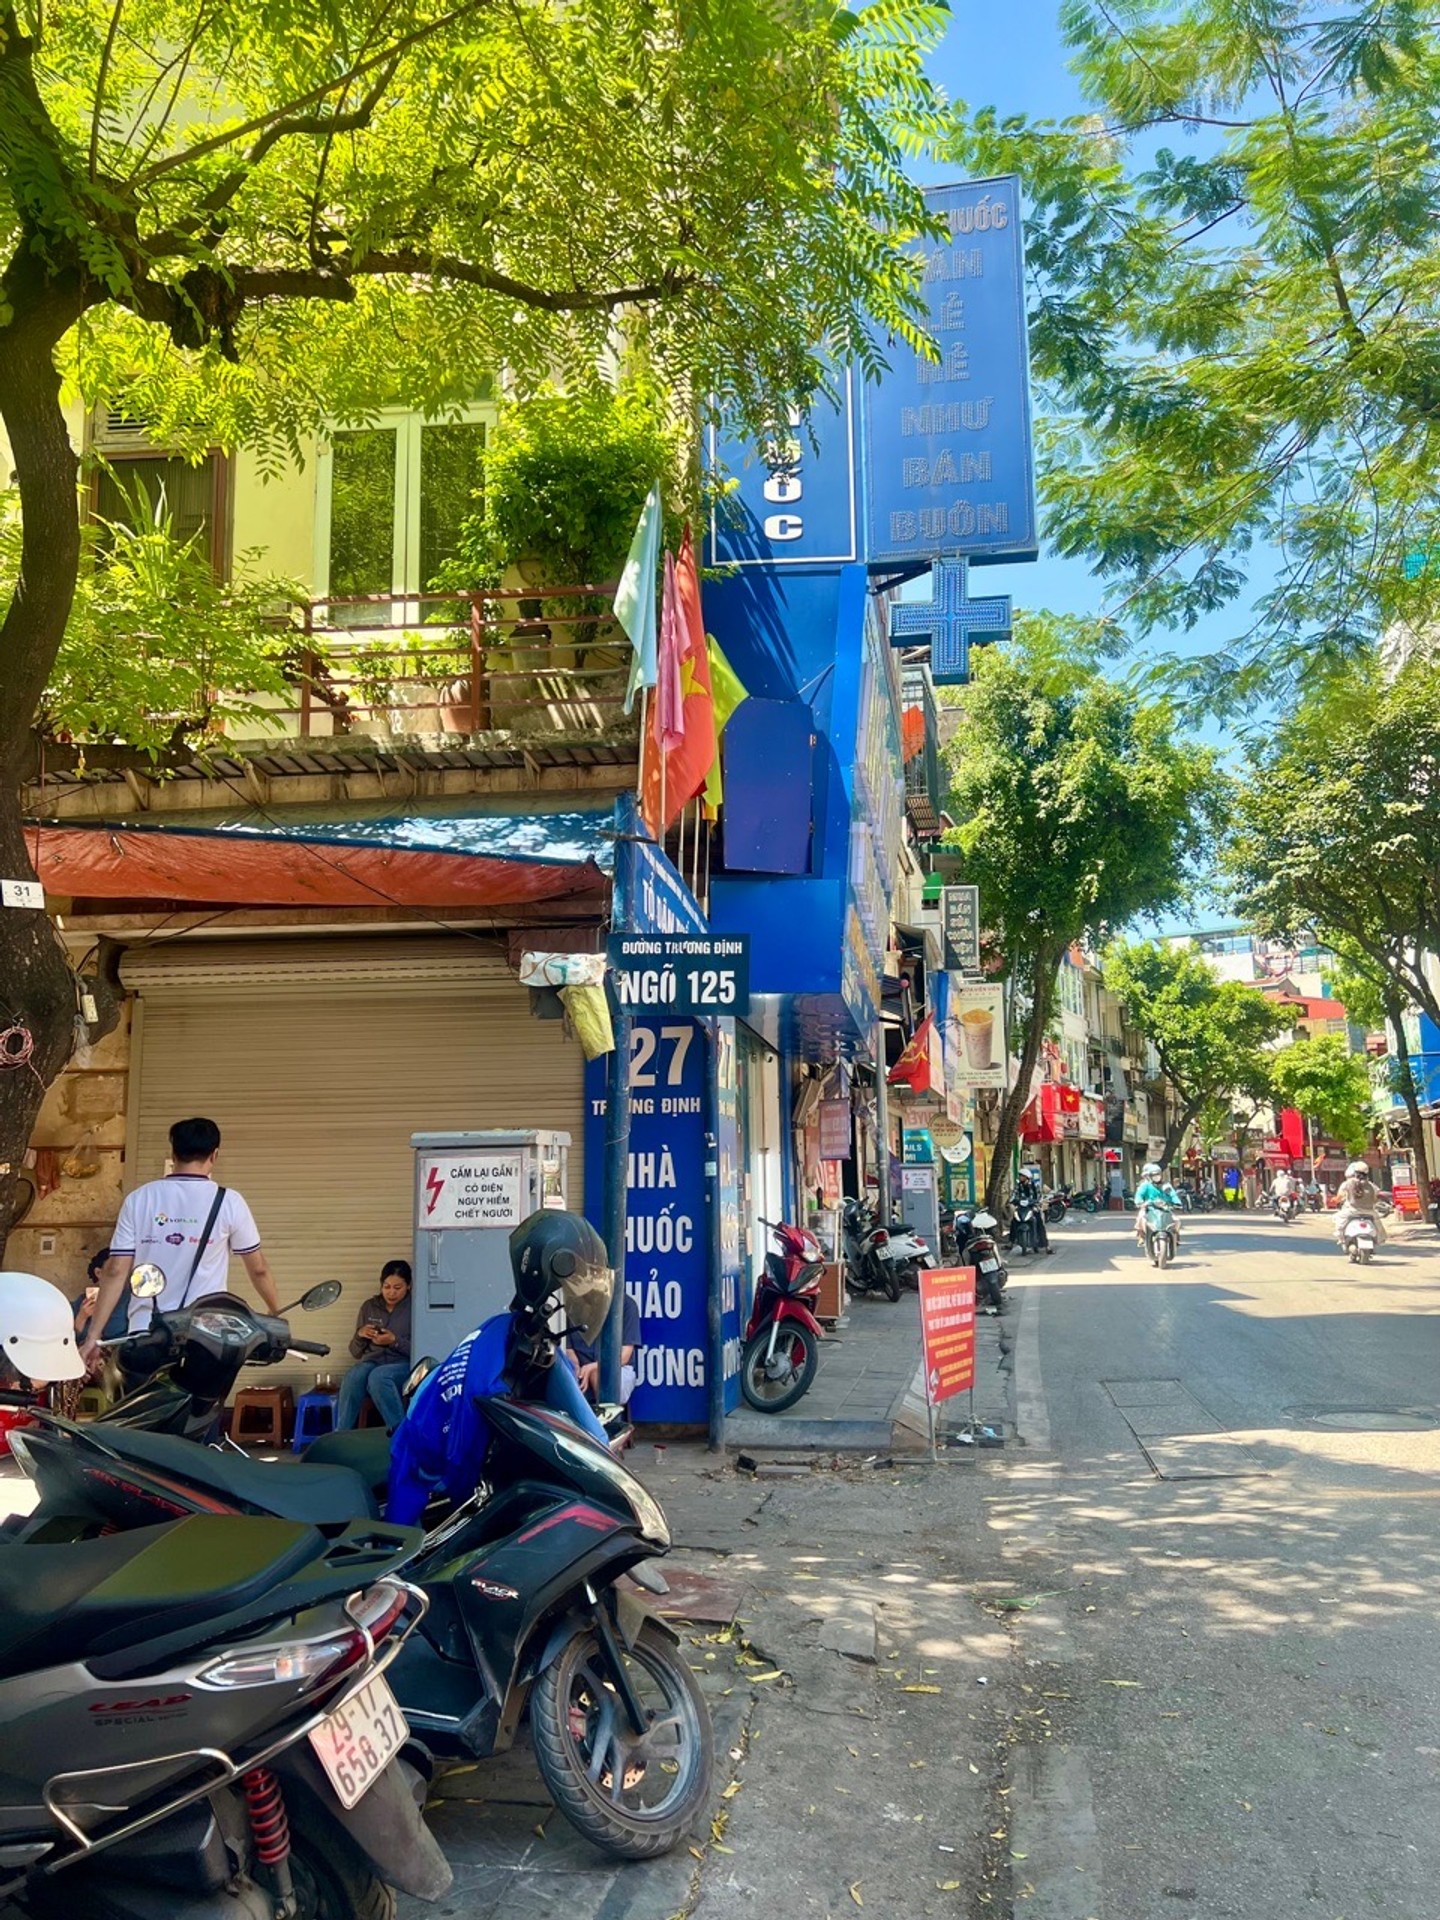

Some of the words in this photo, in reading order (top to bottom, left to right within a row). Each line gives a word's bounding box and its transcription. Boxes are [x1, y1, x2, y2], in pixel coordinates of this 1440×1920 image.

[924, 247, 984, 284] ÁN
[901, 395, 995, 437] NHƯ
[902, 448, 993, 489] BÁN
[889, 499, 1009, 544] BUÔN
[13, 885, 30, 897] 31
[622, 938, 662, 954] ĐƯỜNG
[664, 940, 711, 954] TRƯƠNG
[713, 939, 743, 958] ĐỊNH
[620, 963, 677, 1004] NGÕ
[687, 970, 736, 1004] 125
[591, 1098, 655, 1116] TRNG
[661, 1097, 701, 1118] ĐỊNH
[450, 1164, 472, 1178] CẤM
[474, 1167, 489, 1180] LẠI
[454, 1207, 480, 1218] CHẾT
[457, 1197, 485, 1205] NGUY
[486, 1193, 510, 1205] HIỂM
[624, 1202, 693, 1254] HUỐC
[625, 1267, 682, 1319] HẢO
[635, 1344, 705, 1388] ƯƠNG
[93, 1715, 154, 1727] SPECIAL
[335, 1703, 400, 1797] 658.37
